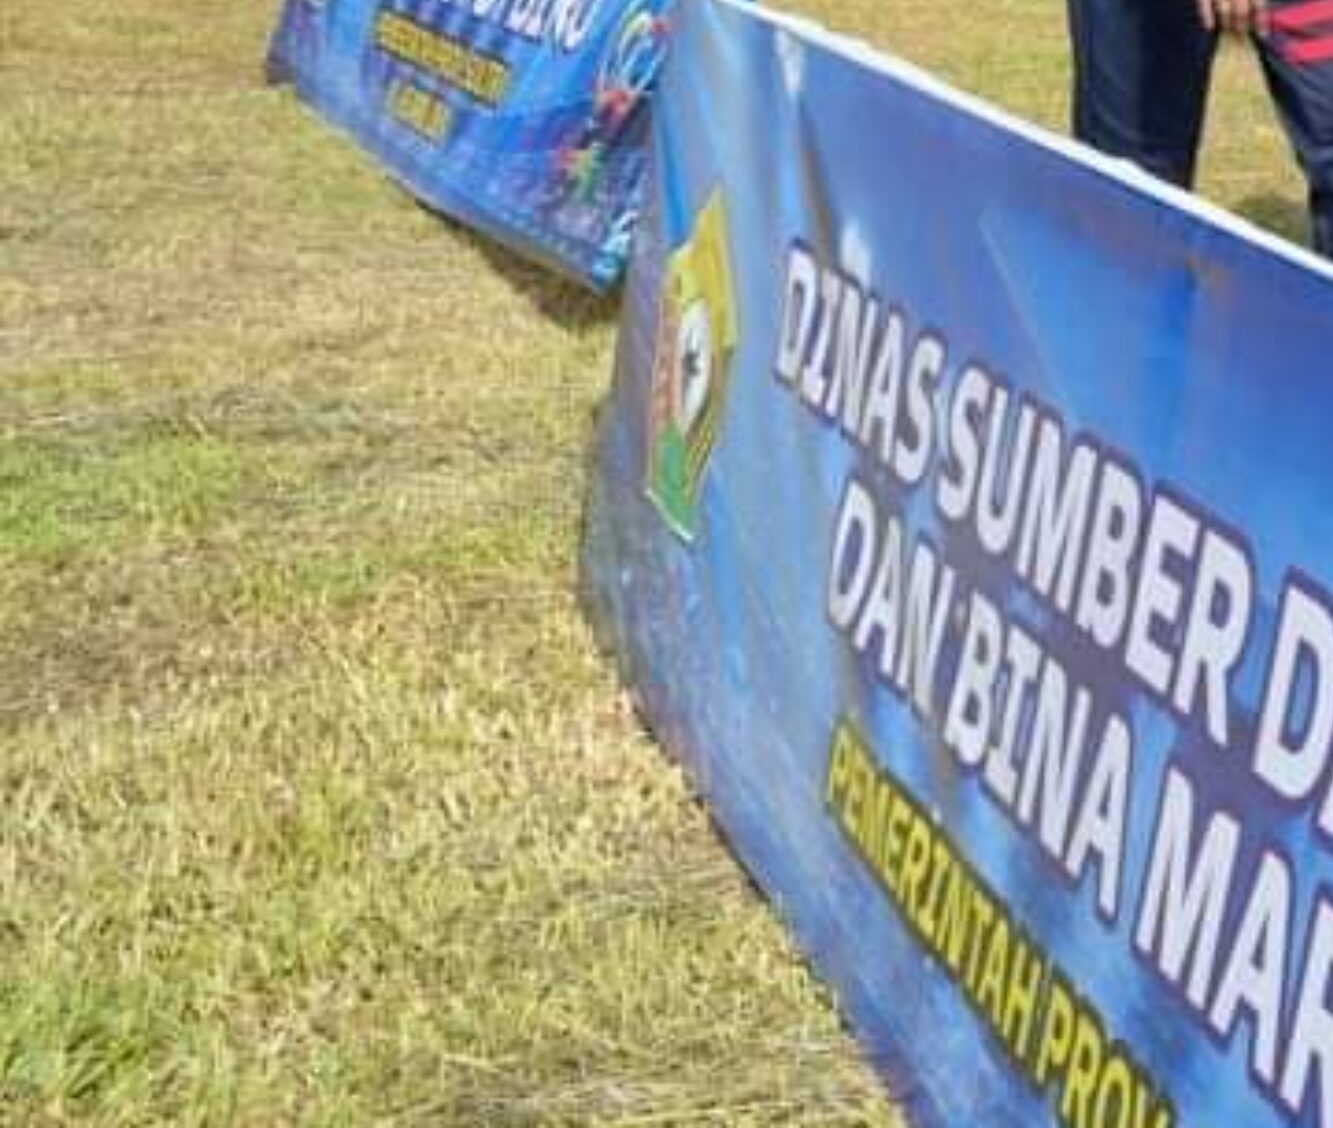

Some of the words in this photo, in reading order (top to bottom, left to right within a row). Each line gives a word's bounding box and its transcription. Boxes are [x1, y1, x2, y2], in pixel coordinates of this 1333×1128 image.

[776, 252, 944, 483] DINAS
[937, 368, 1252, 746] SUMBER
[828, 483, 953, 718] DAN
[943, 590, 1131, 921] BINA
[828, 722, 1042, 1059] PEMERINTAH
